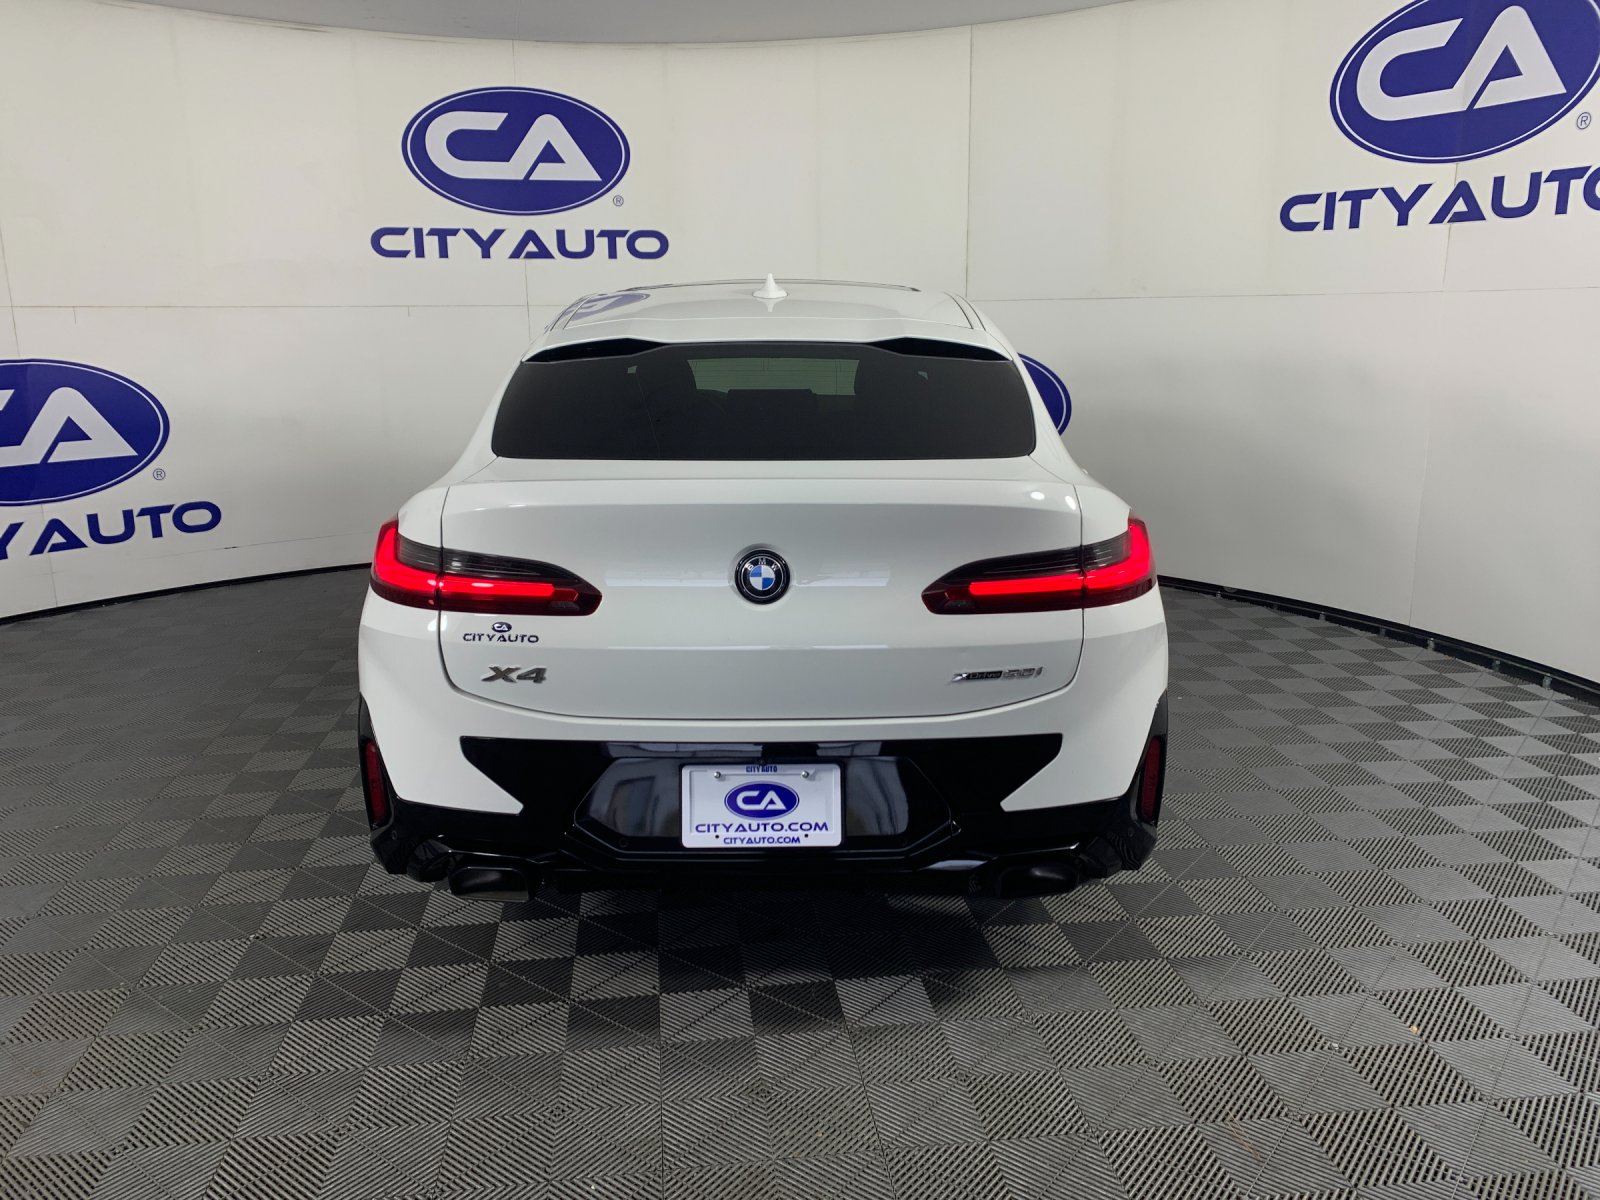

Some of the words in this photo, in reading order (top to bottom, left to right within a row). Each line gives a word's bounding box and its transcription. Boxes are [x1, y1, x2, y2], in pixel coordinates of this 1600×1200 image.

[1357, 5, 1567, 121] CA
[425, 110, 602, 180] CA
[0, 386, 139, 468] A
[481, 665, 547, 684] X4
[736, 790, 787, 810] CA
